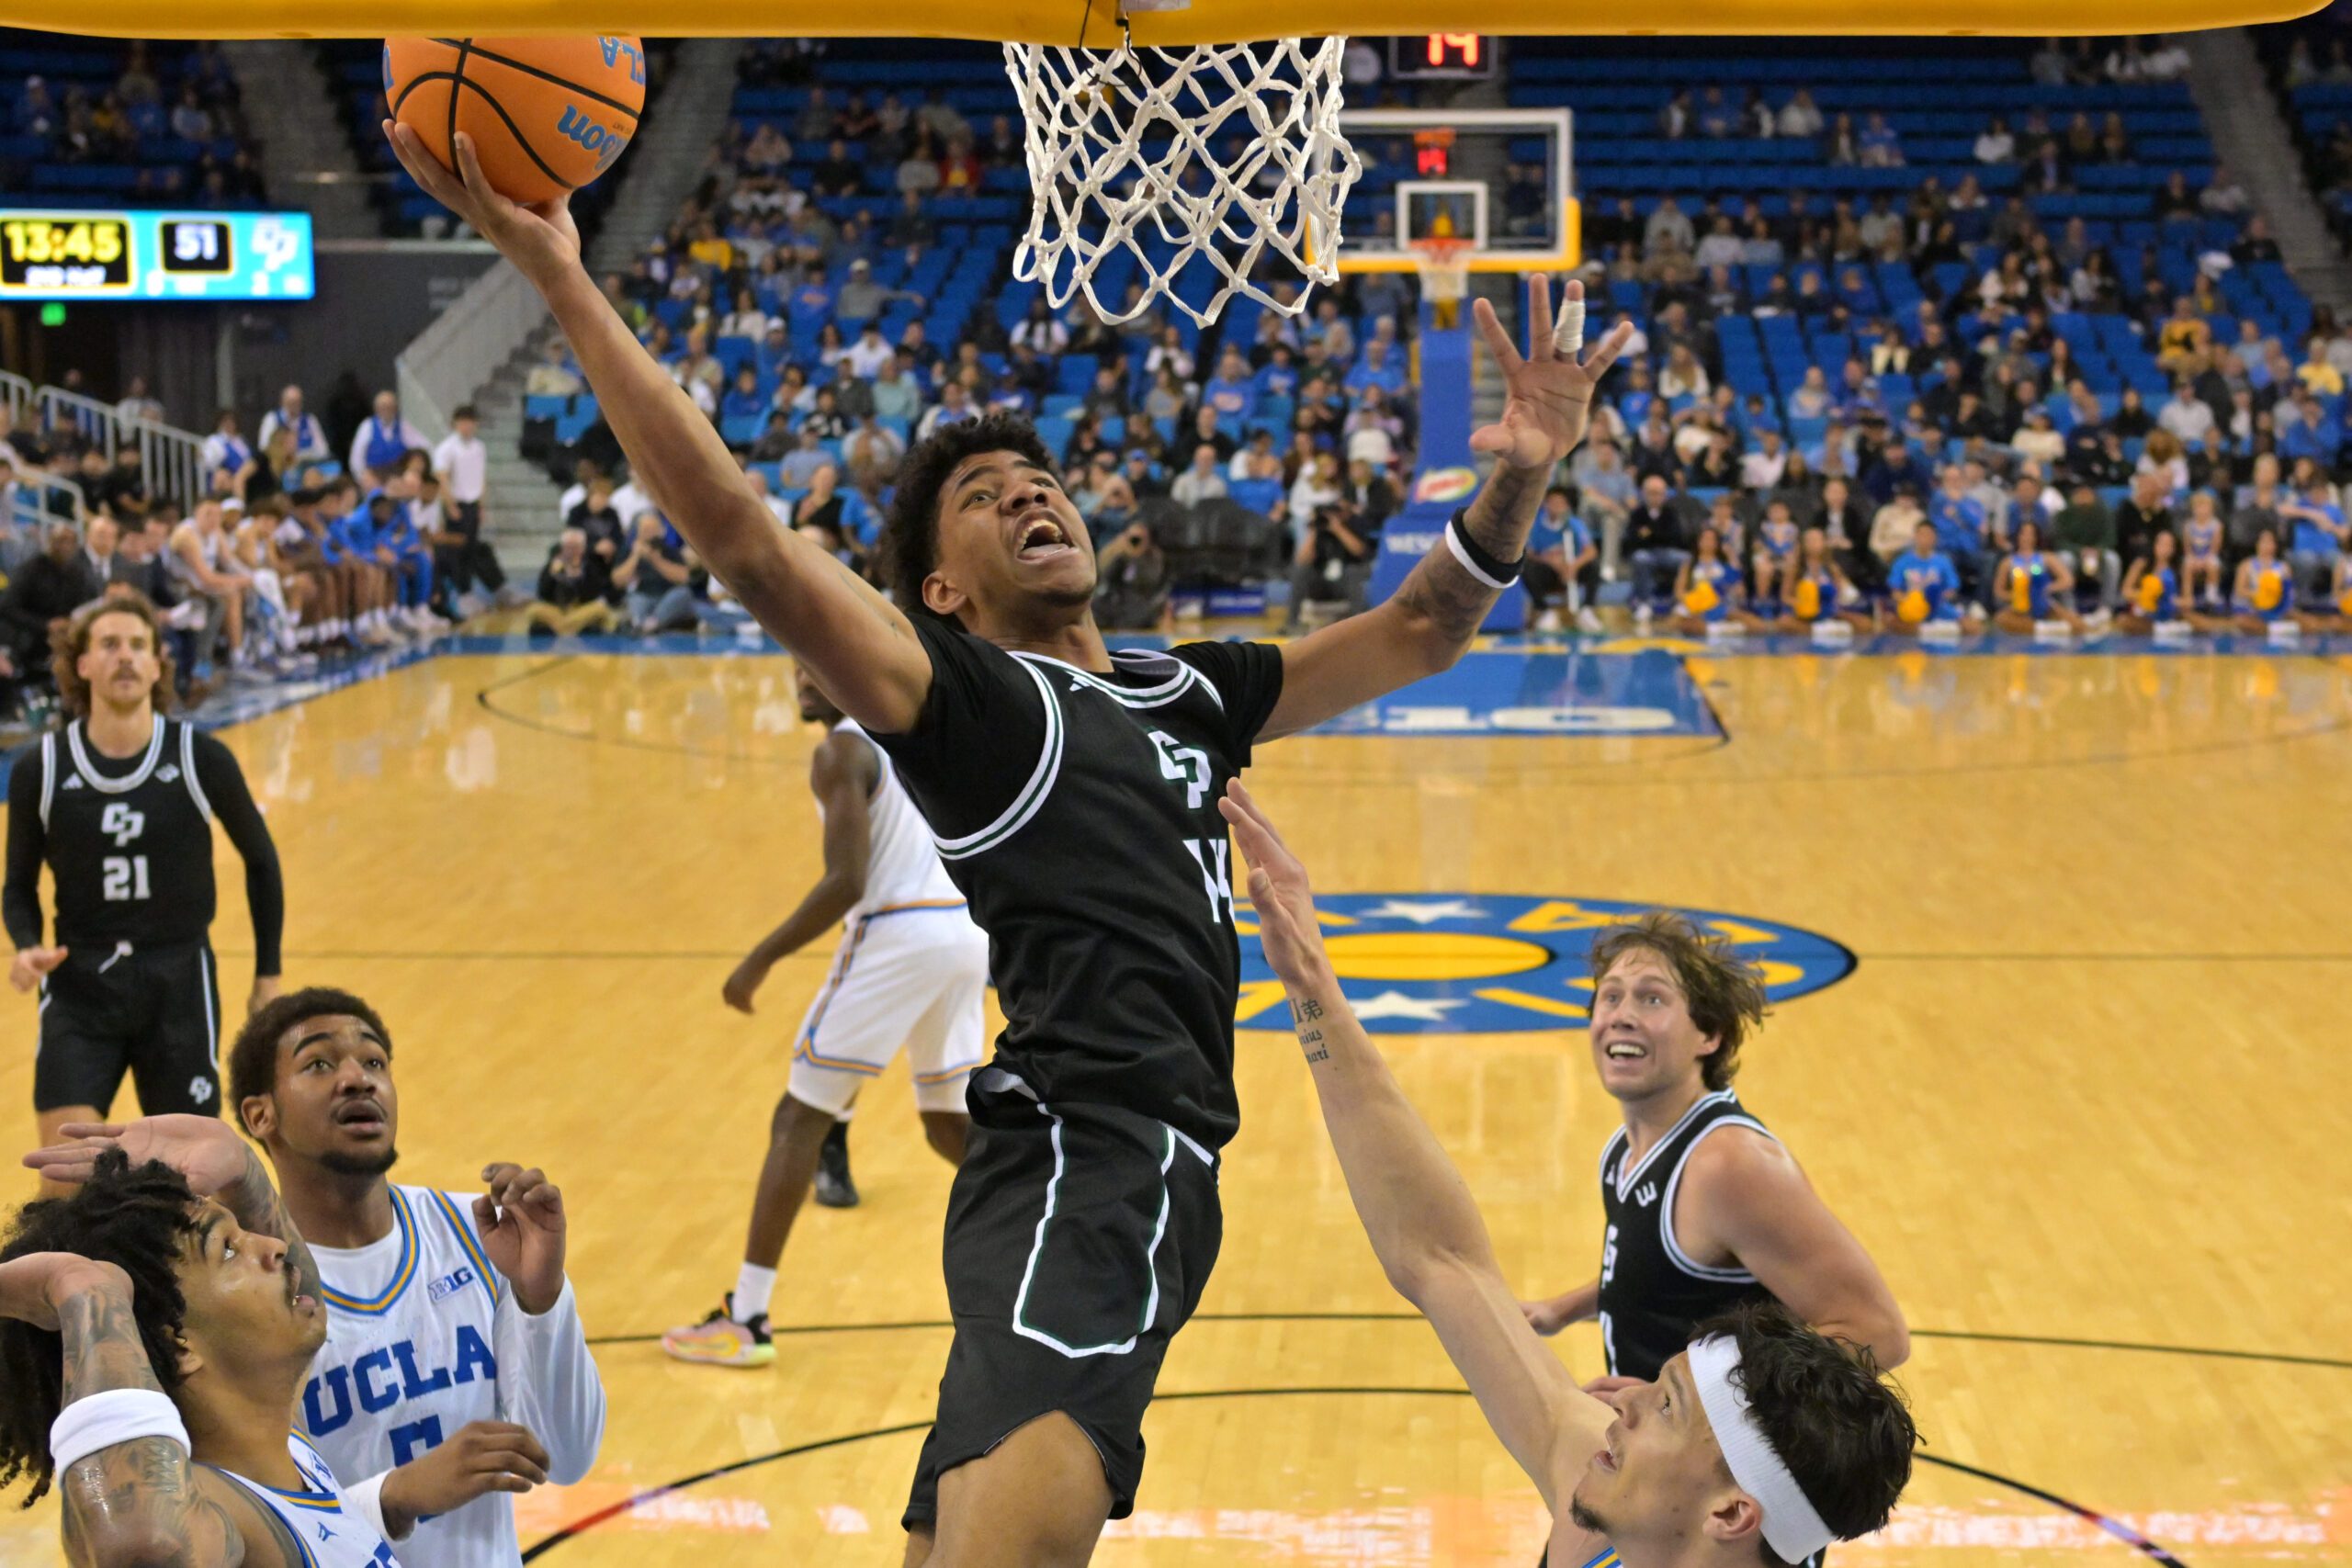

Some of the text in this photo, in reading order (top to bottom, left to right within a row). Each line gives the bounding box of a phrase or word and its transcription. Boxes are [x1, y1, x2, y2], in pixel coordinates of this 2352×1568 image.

[5, 222, 122, 263] 13:45
[175, 223, 218, 261] 51
[103, 855, 151, 901] 21
[301, 1325, 497, 1438] UCLA
